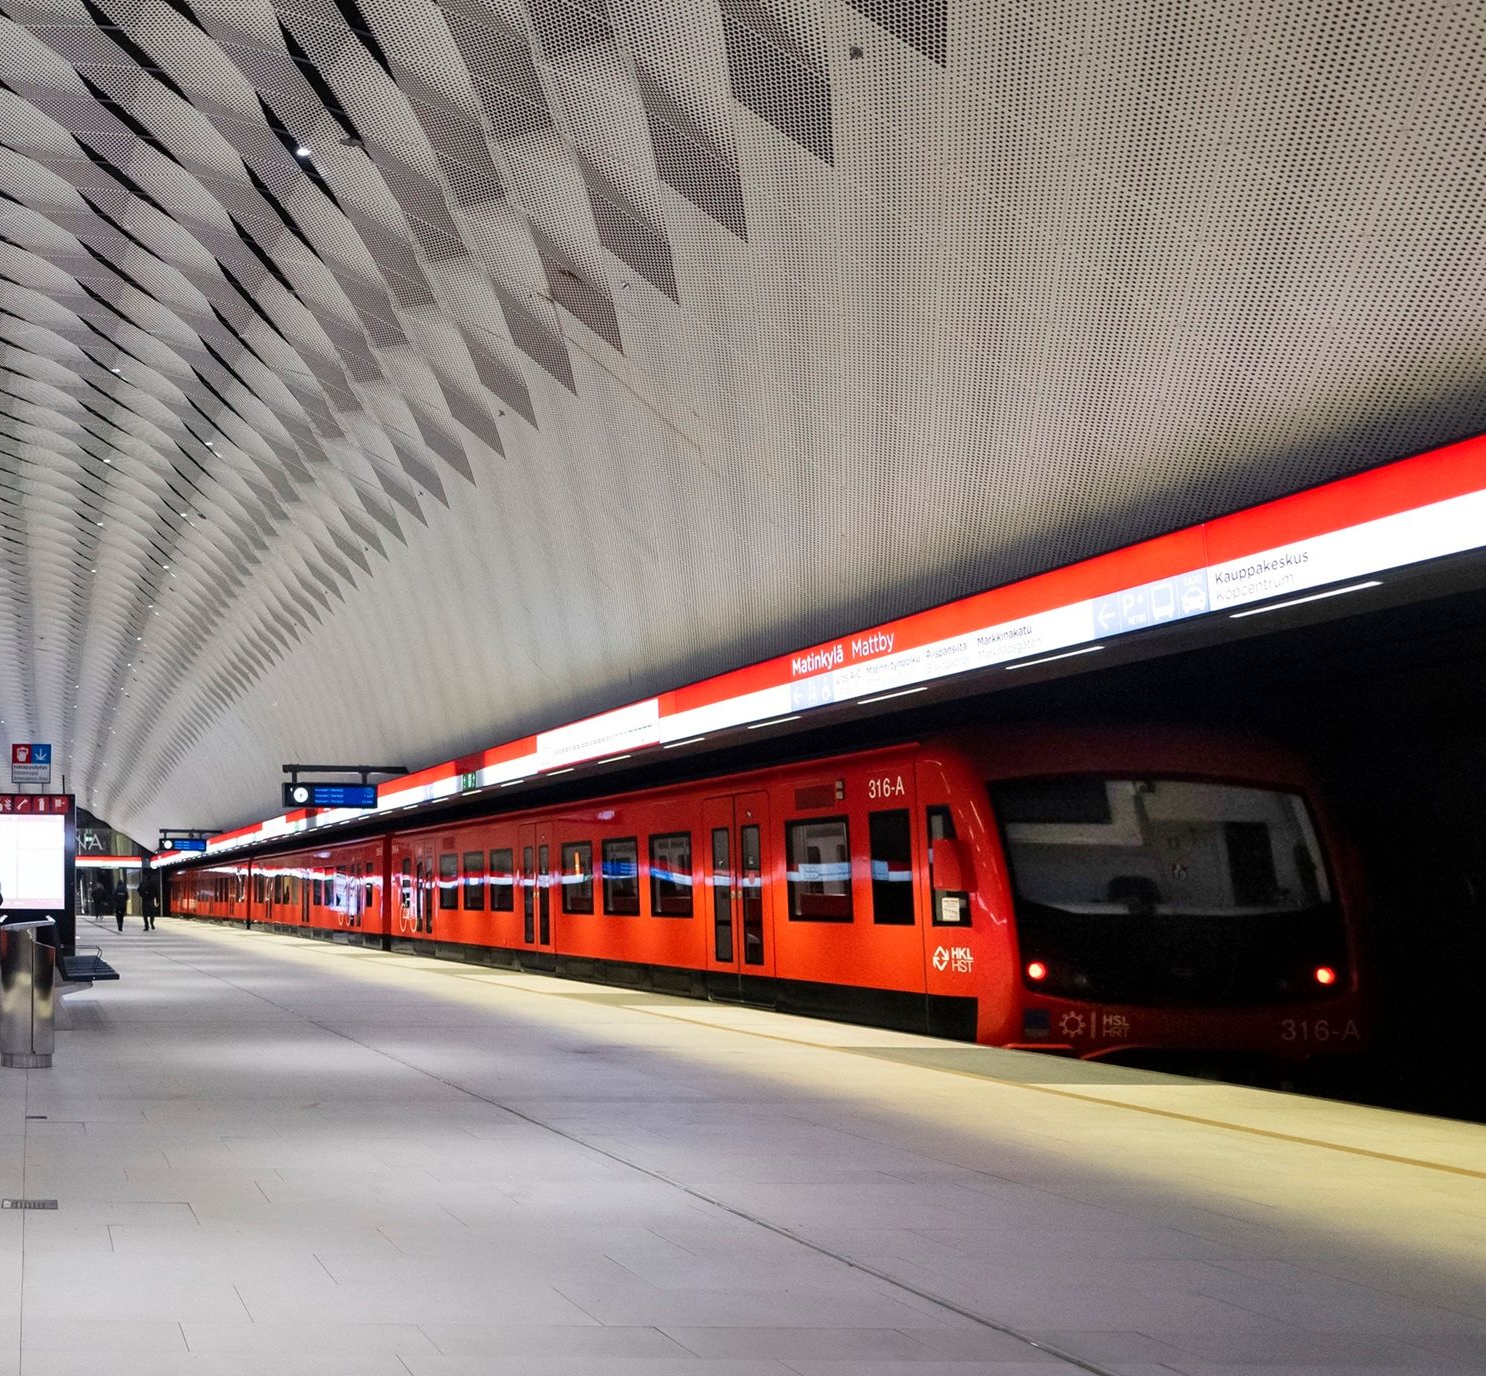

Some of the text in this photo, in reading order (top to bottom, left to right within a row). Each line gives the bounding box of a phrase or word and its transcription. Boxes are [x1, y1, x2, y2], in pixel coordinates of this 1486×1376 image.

[1214, 551, 1309, 585] Kauppakeskus
[851, 631, 895, 660] Mattby
[977, 624, 1032, 647] Markkinakatu
[792, 644, 844, 676] Matinkylä
[868, 775, 905, 799] 316-A
[951, 947, 974, 960] HKL
[951, 960, 974, 973] HST
[1103, 1015, 1129, 1027] HSL
[1281, 1020, 1361, 1042] 316-A
[1103, 1027, 1130, 1038] HRT
